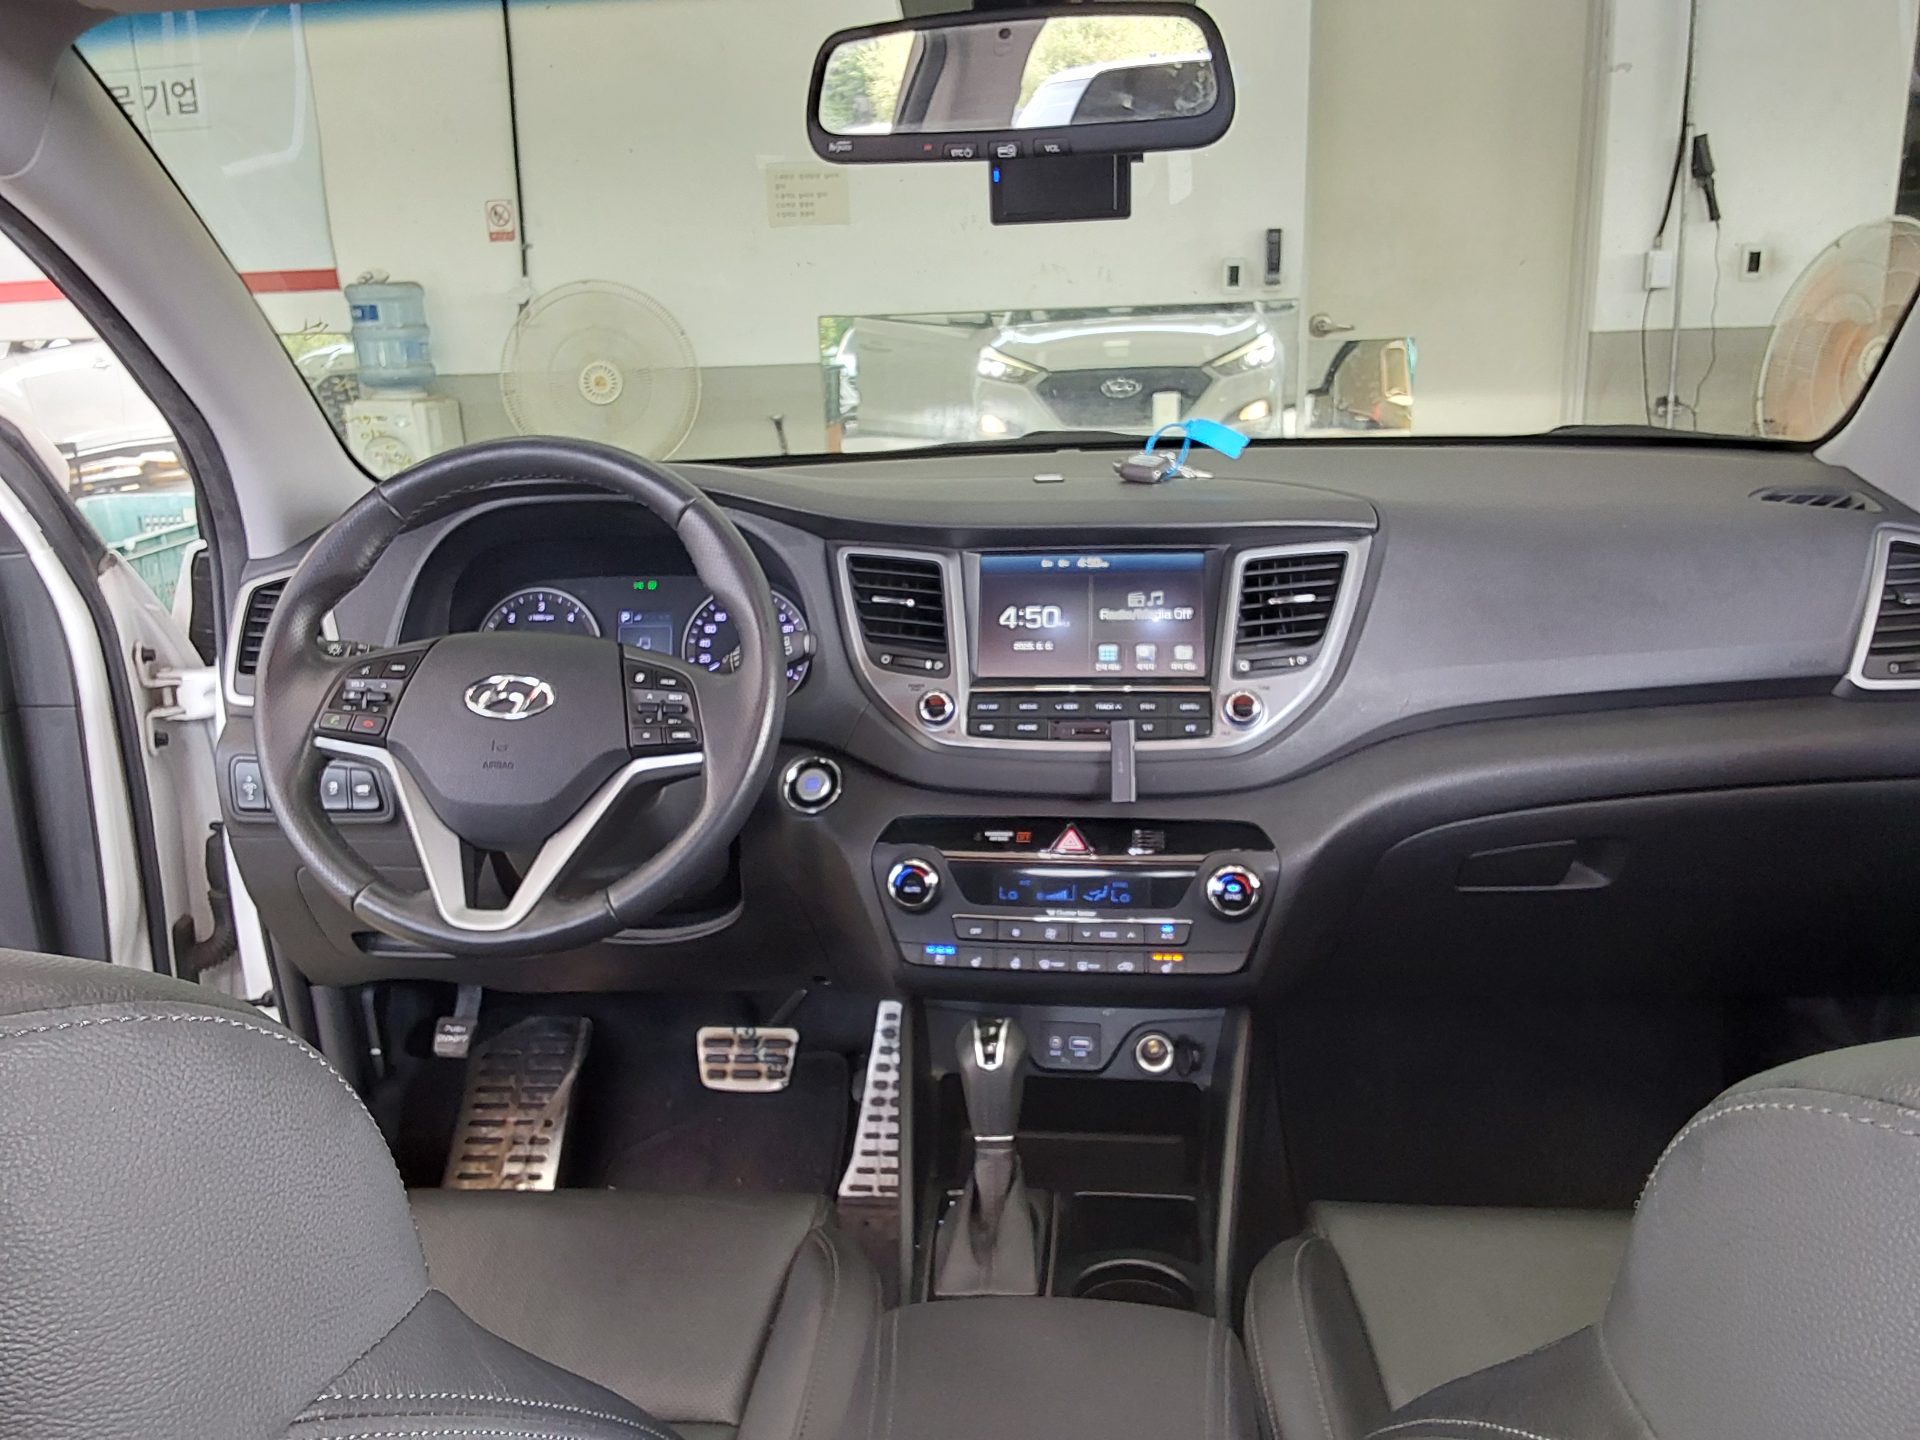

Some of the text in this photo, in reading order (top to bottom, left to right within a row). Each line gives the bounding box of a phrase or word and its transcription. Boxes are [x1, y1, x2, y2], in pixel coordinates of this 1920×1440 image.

[1044, 144, 1061, 153] VOL
[537, 601, 546, 612] 3
[507, 611, 516, 623] 2
[999, 605, 1062, 629] 4:50
[1173, 607, 1194, 620] Off
[698, 653, 711, 664] 20
[1095, 703, 1114, 711] TRACK
[1016, 831, 1032, 842] OFF
